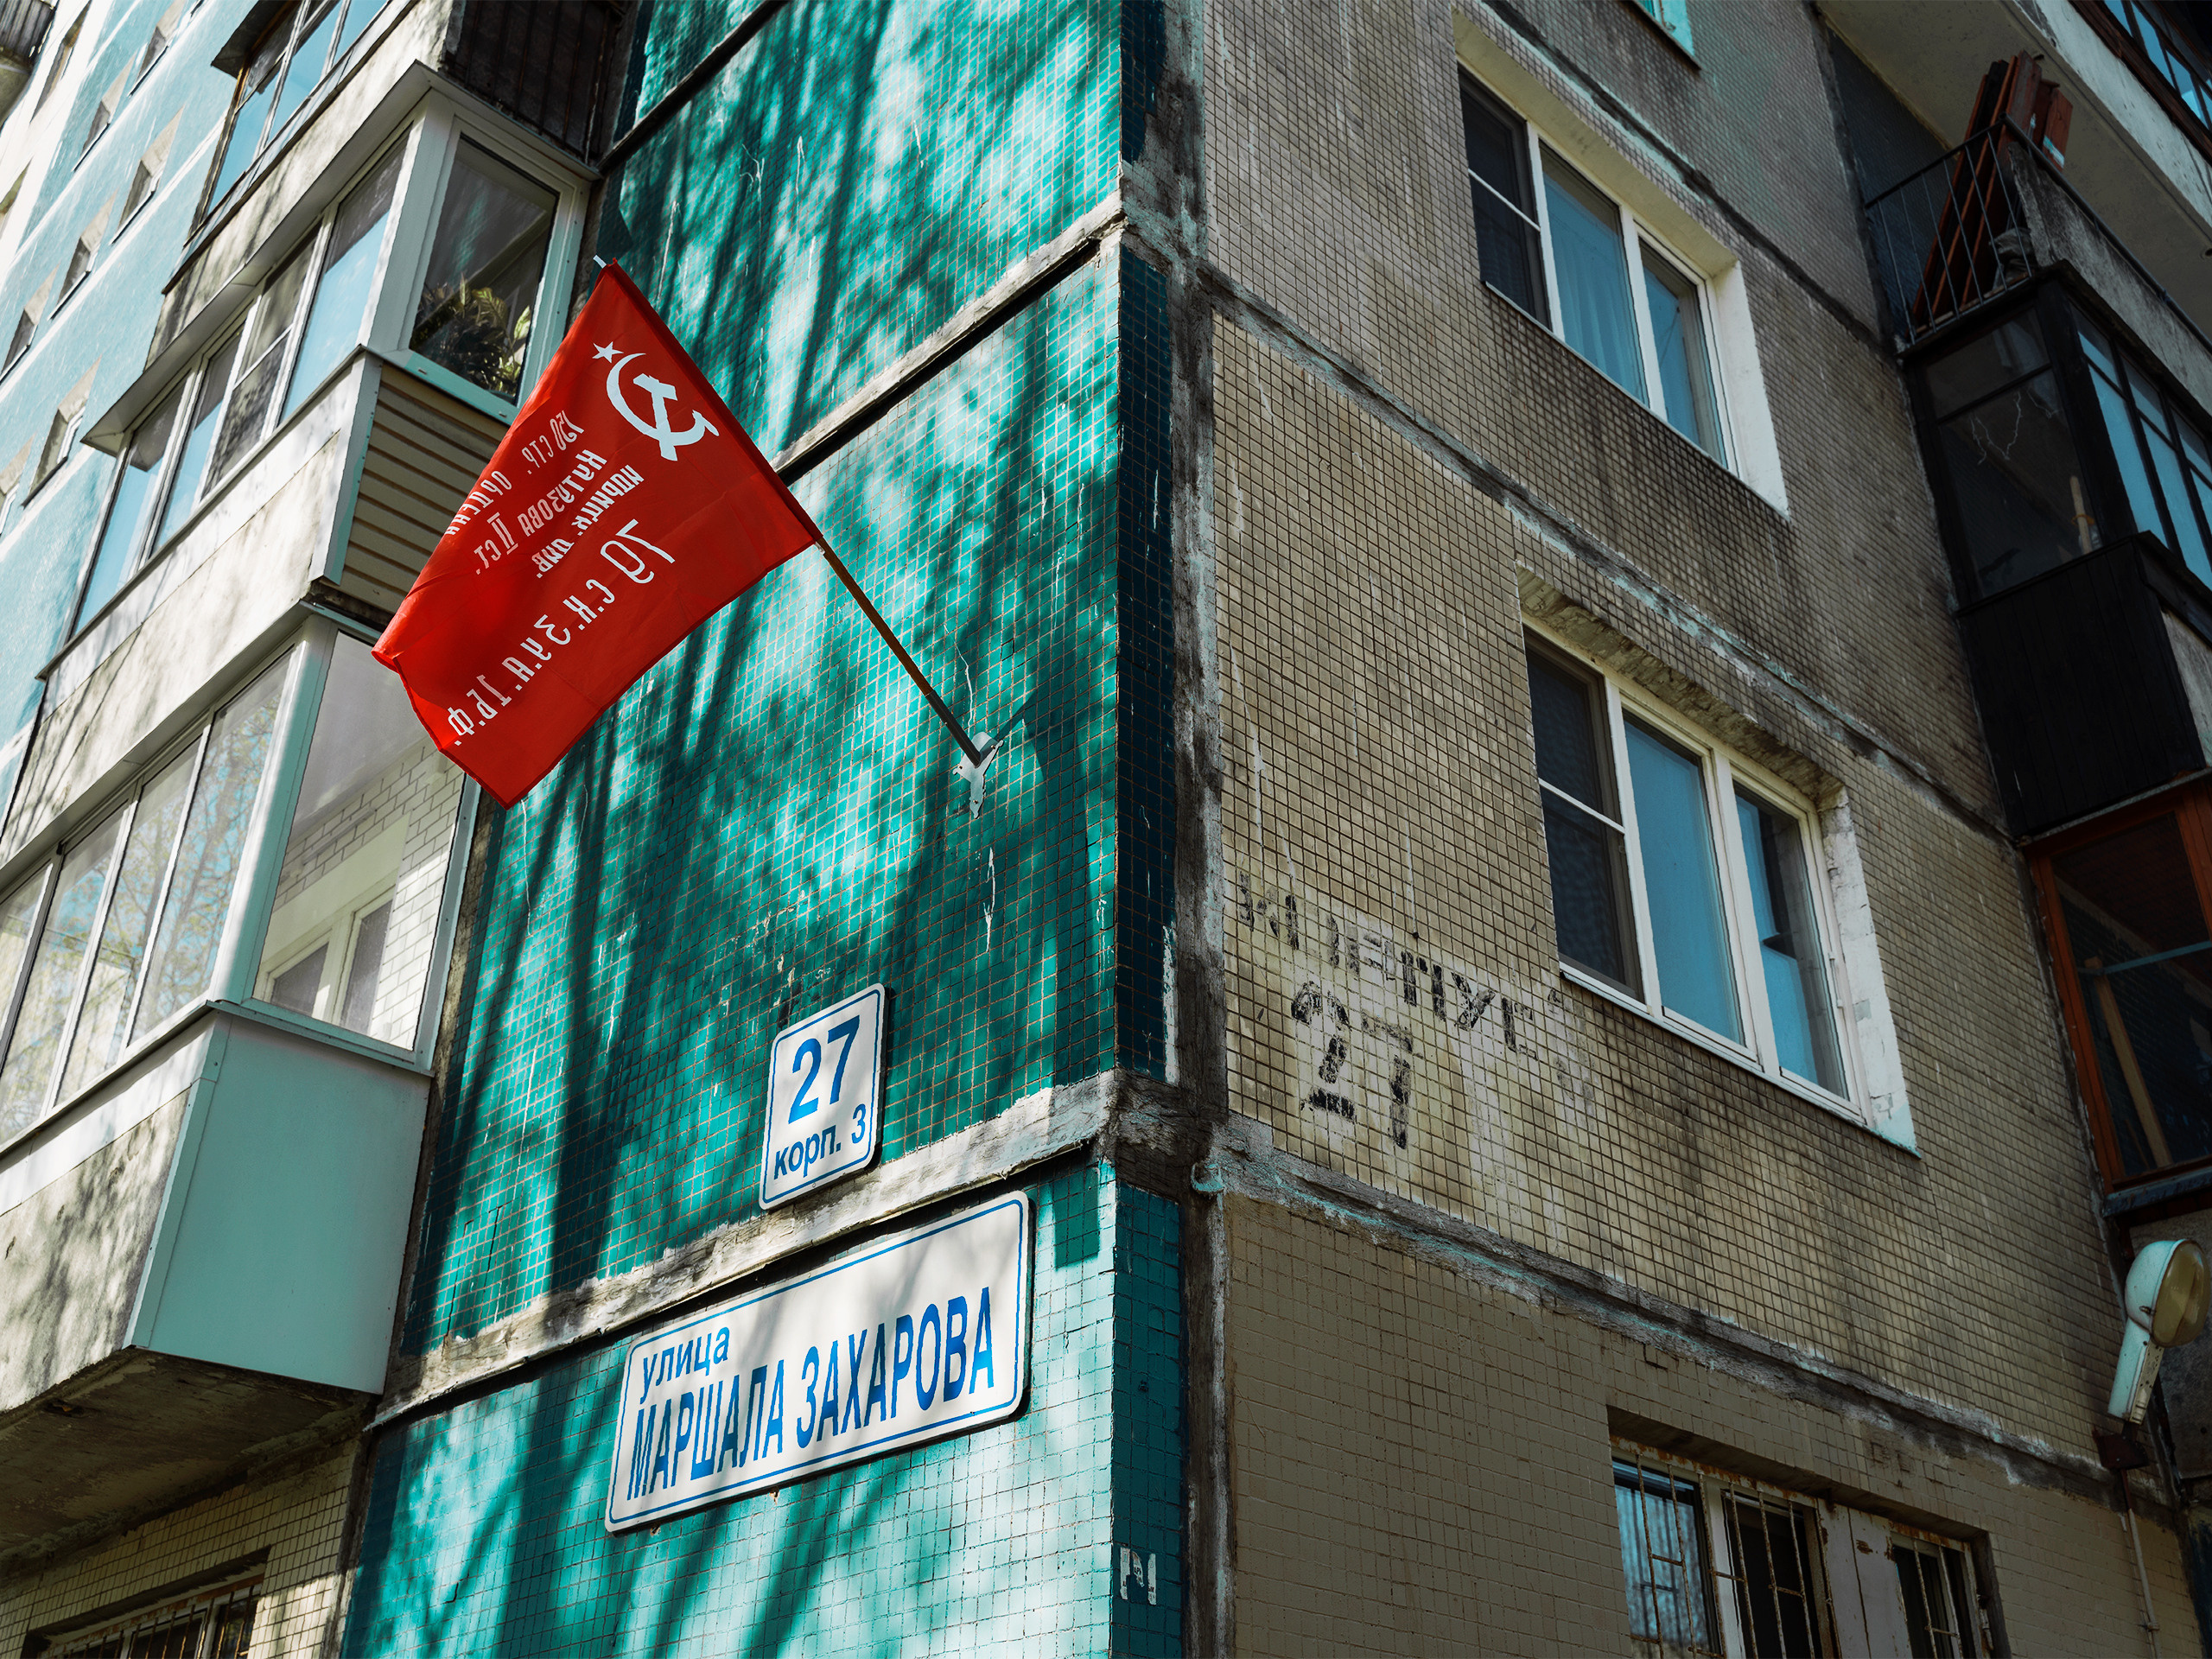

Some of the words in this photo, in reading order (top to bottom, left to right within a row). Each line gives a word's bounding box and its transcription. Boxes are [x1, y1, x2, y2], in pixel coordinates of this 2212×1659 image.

[787, 1014, 861, 1124] 27
[1290, 980, 1414, 1150] 27
[773, 1125, 842, 1180] корп.
[850, 1103, 867, 1145] 3
[626, 1359, 785, 1501] МАРШАЛА
[796, 1286, 995, 1449] ЗАХАРОВА
[639, 1326, 730, 1405] улица
